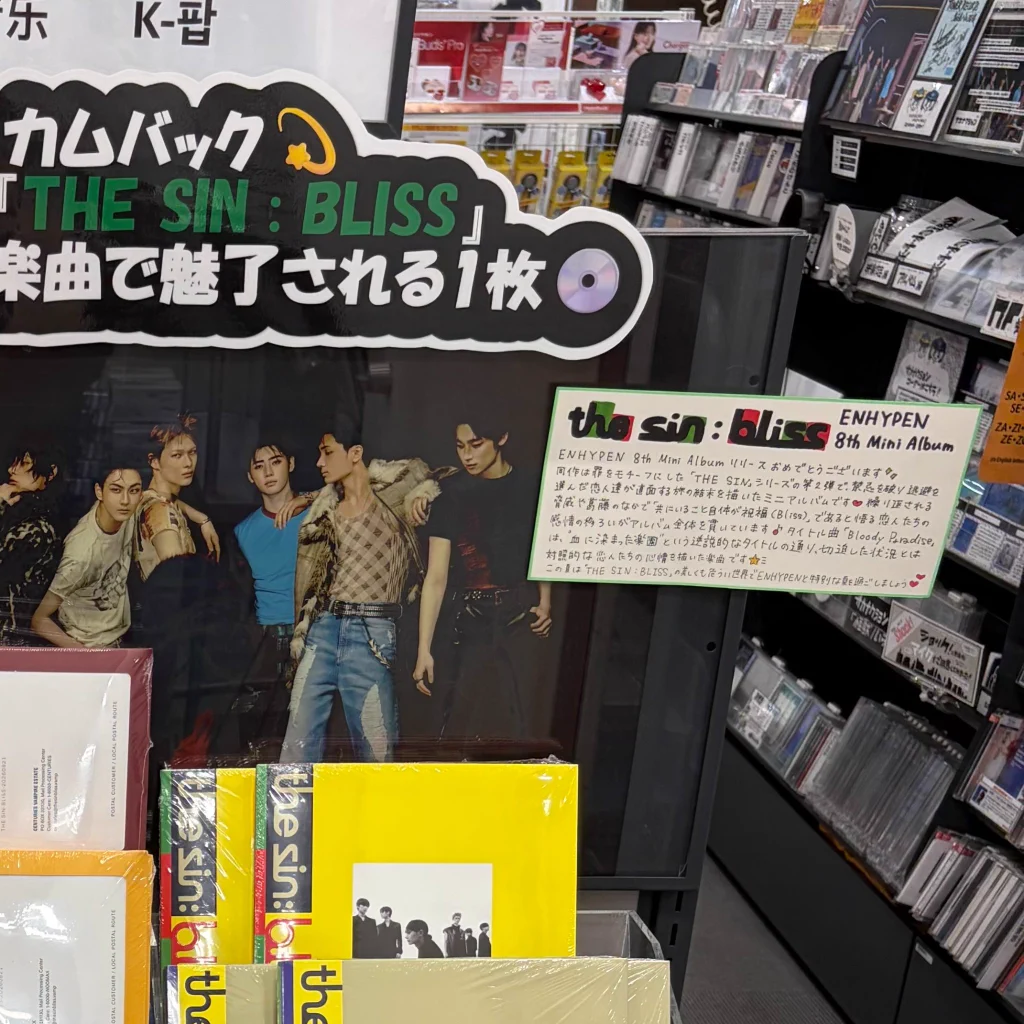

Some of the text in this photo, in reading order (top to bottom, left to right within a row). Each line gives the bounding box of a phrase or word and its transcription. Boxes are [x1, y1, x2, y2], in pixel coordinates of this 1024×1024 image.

[133, 3, 218, 47] K-팝
[4, 106, 265, 172] カムバック
[160, 177, 251, 234] SIN
[568, 400, 635, 442] the
[839, 408, 930, 429] ENHYPEN
[558, 449, 625, 462] ENHYPEN
[633, 452, 652, 464] 8th
[687, 454, 725, 467] Album
[834, 432, 954, 452] 8th Mini Album
